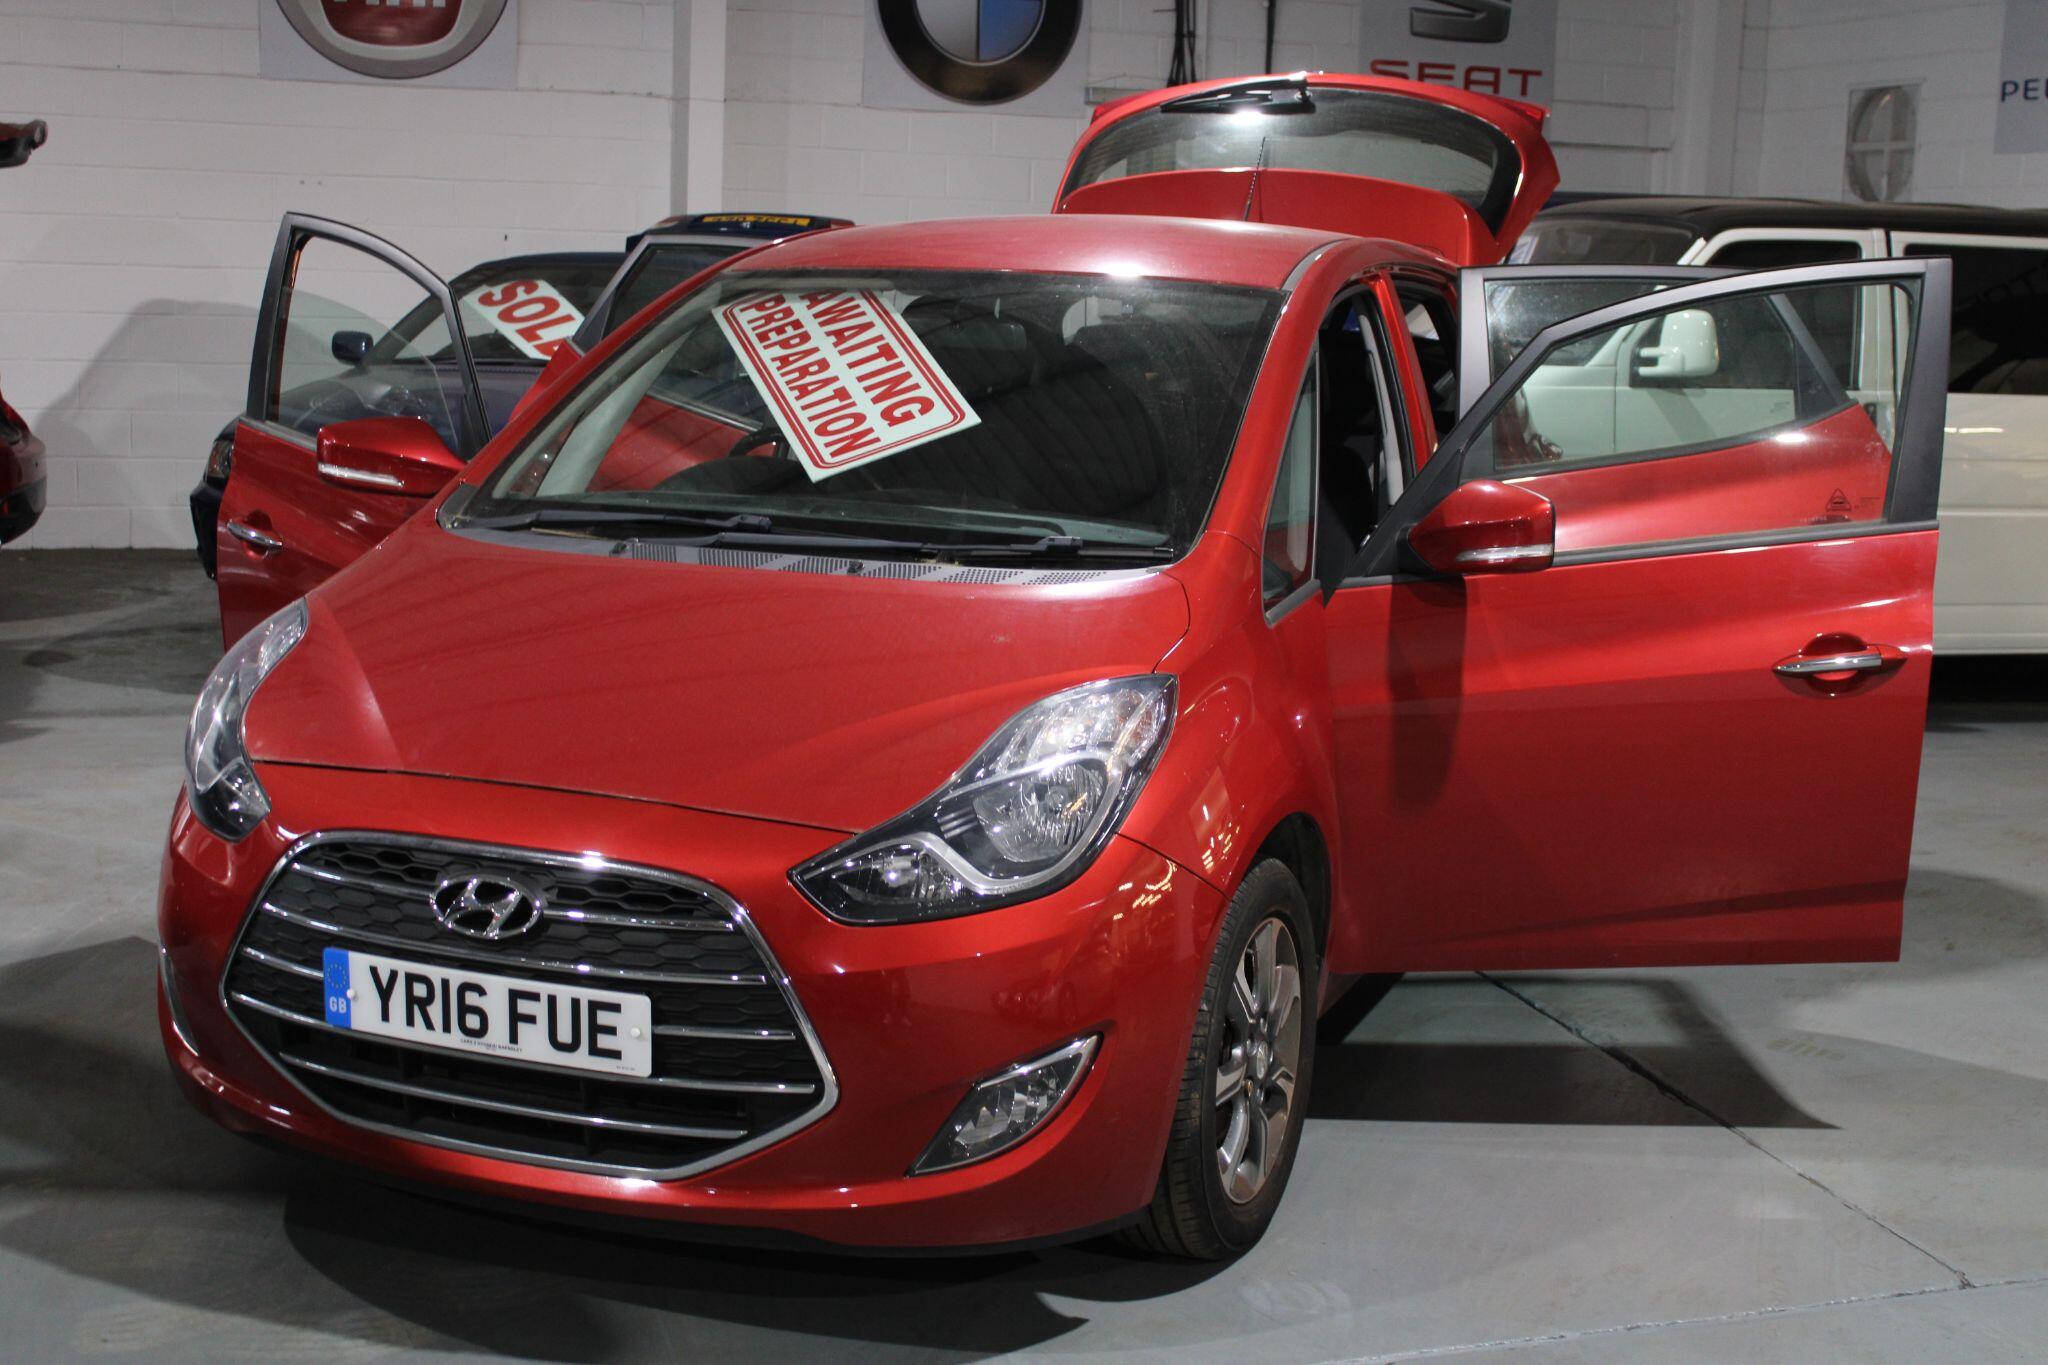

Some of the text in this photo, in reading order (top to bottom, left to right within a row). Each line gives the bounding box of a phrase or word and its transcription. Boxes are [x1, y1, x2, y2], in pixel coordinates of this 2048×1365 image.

[1370, 59, 1543, 97] SEAT
[2001, 78, 2048, 102] PE
[739, 294, 882, 459] PREPARATION
[799, 288, 935, 428] AWAITING
[329, 996, 347, 1014] GB
[369, 965, 622, 1061] YR16 FUE
